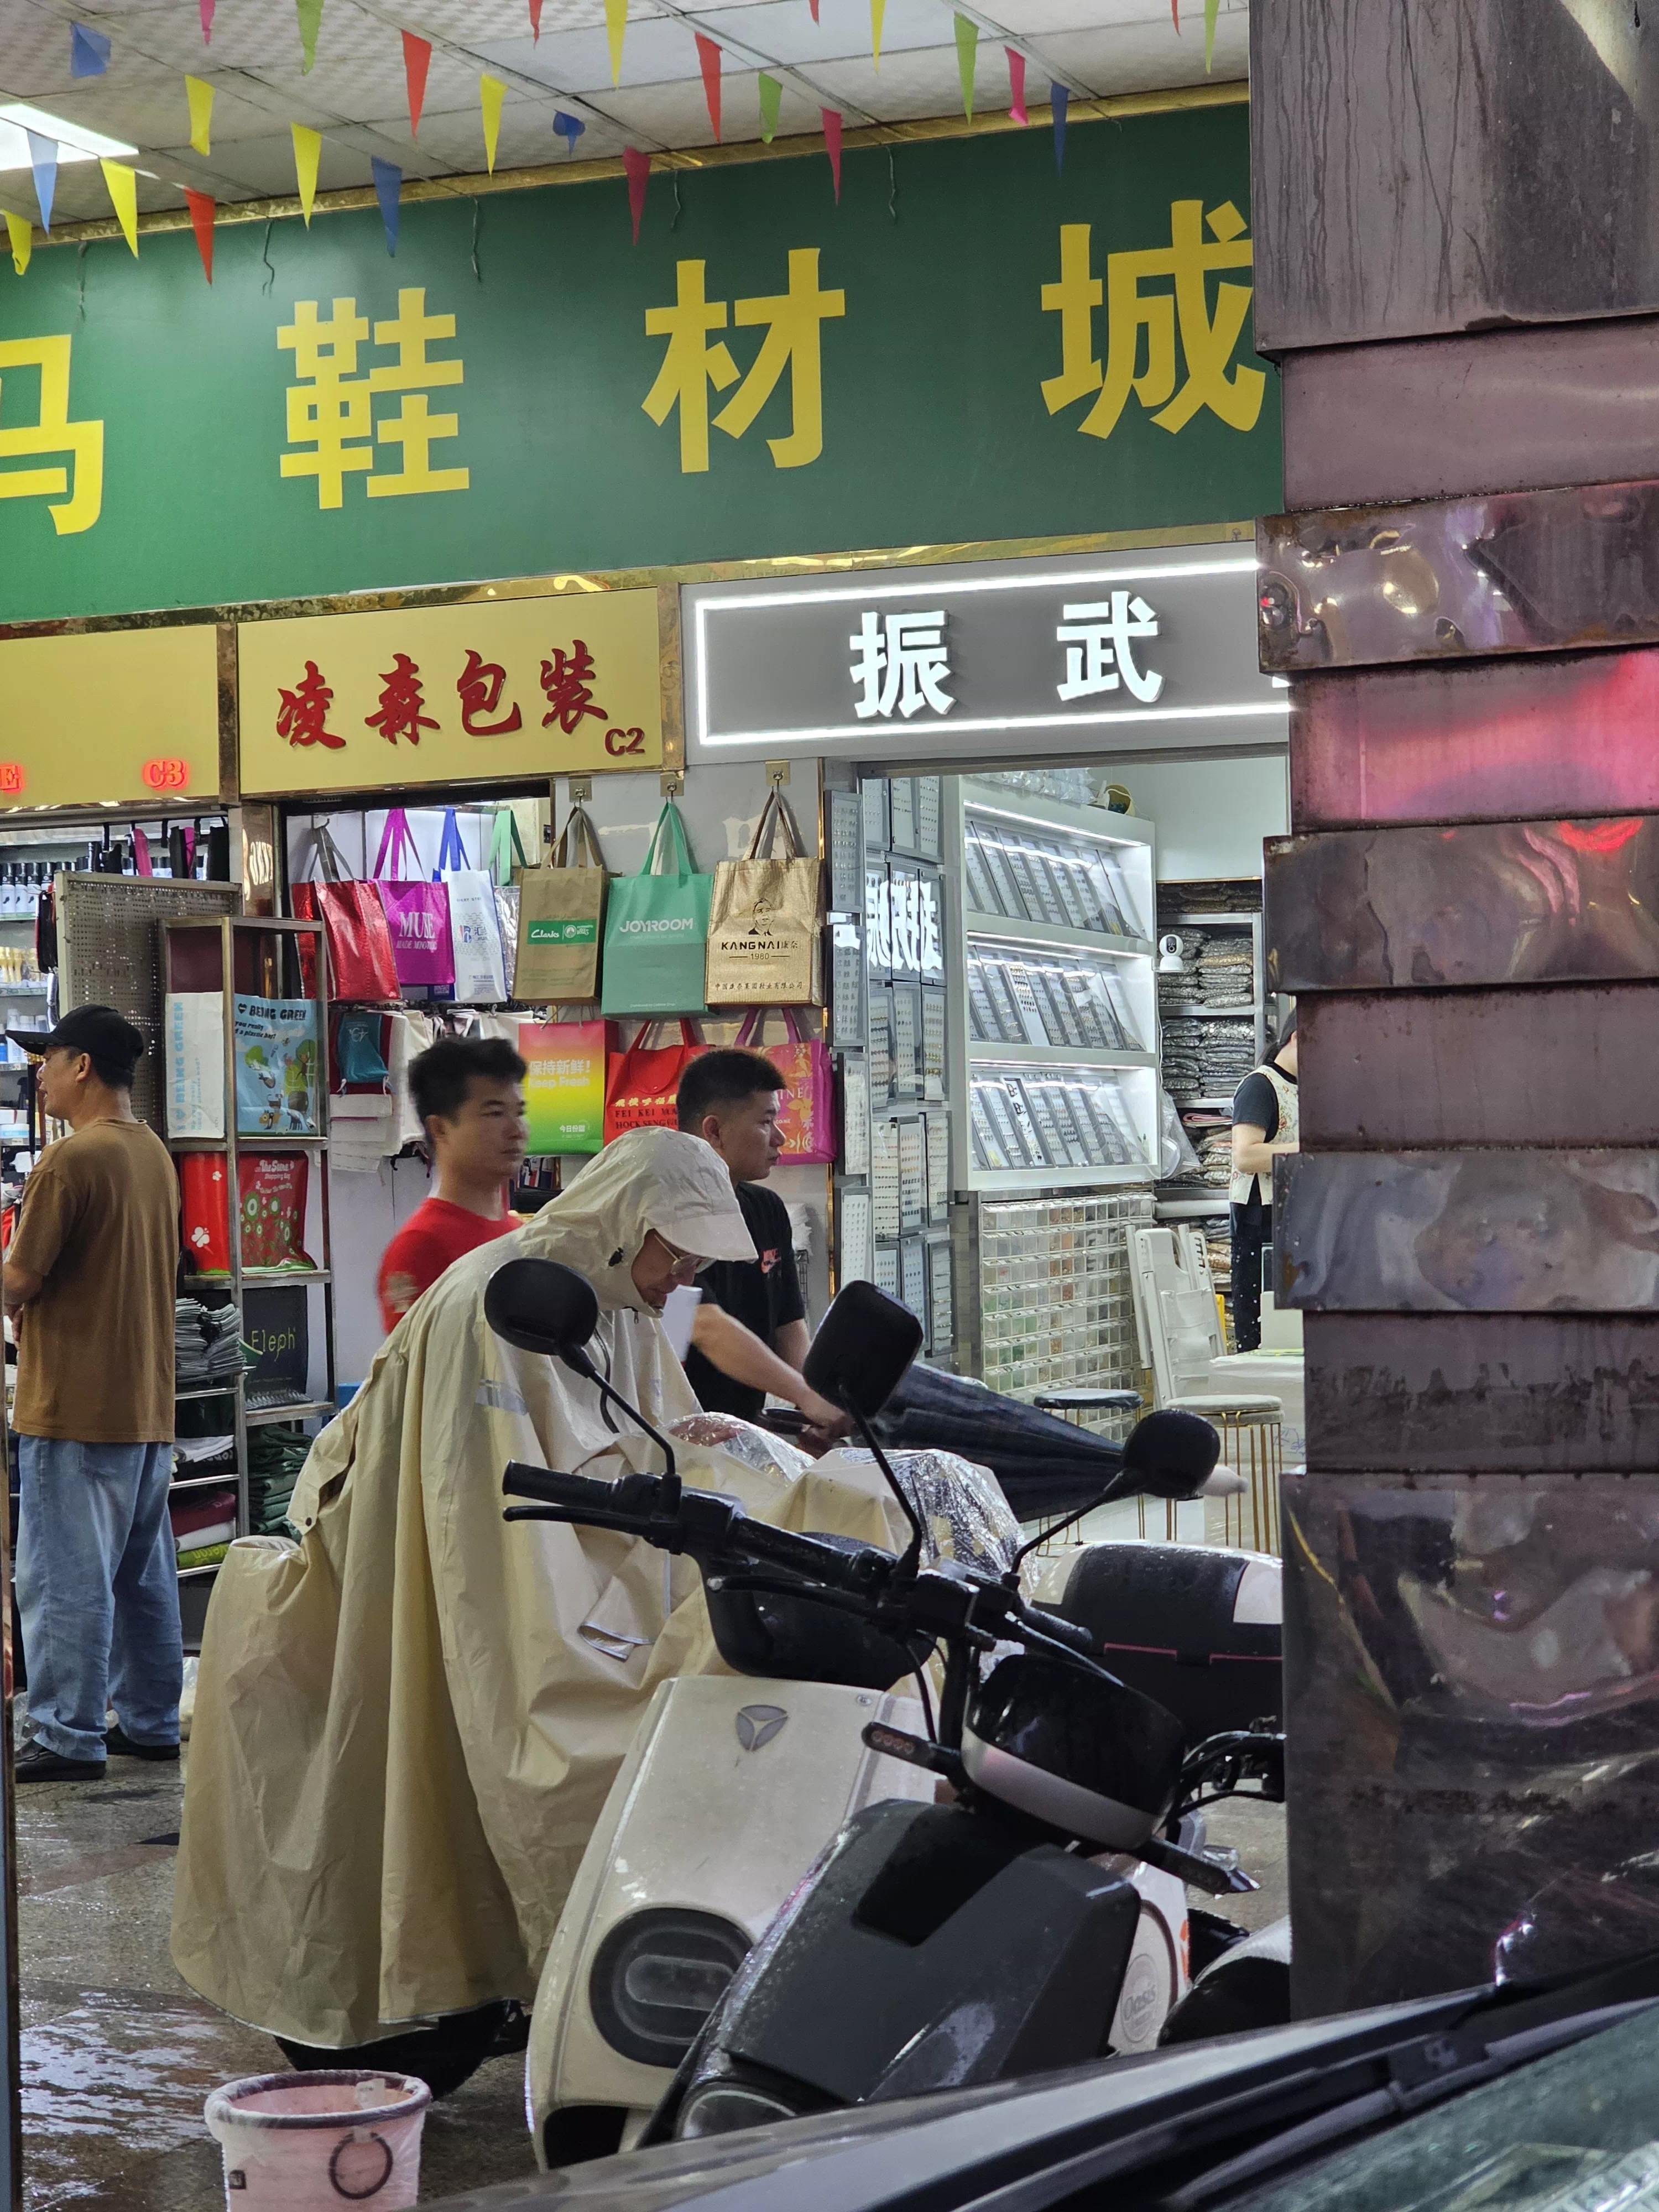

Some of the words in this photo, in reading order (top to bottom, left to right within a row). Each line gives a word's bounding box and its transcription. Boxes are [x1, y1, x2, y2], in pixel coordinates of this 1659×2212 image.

[849, 590, 1290, 718] 振武
[604, 728, 645, 755] C2
[144, 759, 186, 789] C3
[619, 918, 693, 932] JOYROOM
[531, 929, 560, 938] Clarks
[721, 941, 780, 950] KANGNAI
[249, 1005, 276, 1020] BEING
[174, 1002, 184, 1051] GREEN
[175, 1057, 186, 1103] BEING
[559, 1076, 590, 1087] Fresh
[615, 1109, 632, 1118] FEI
